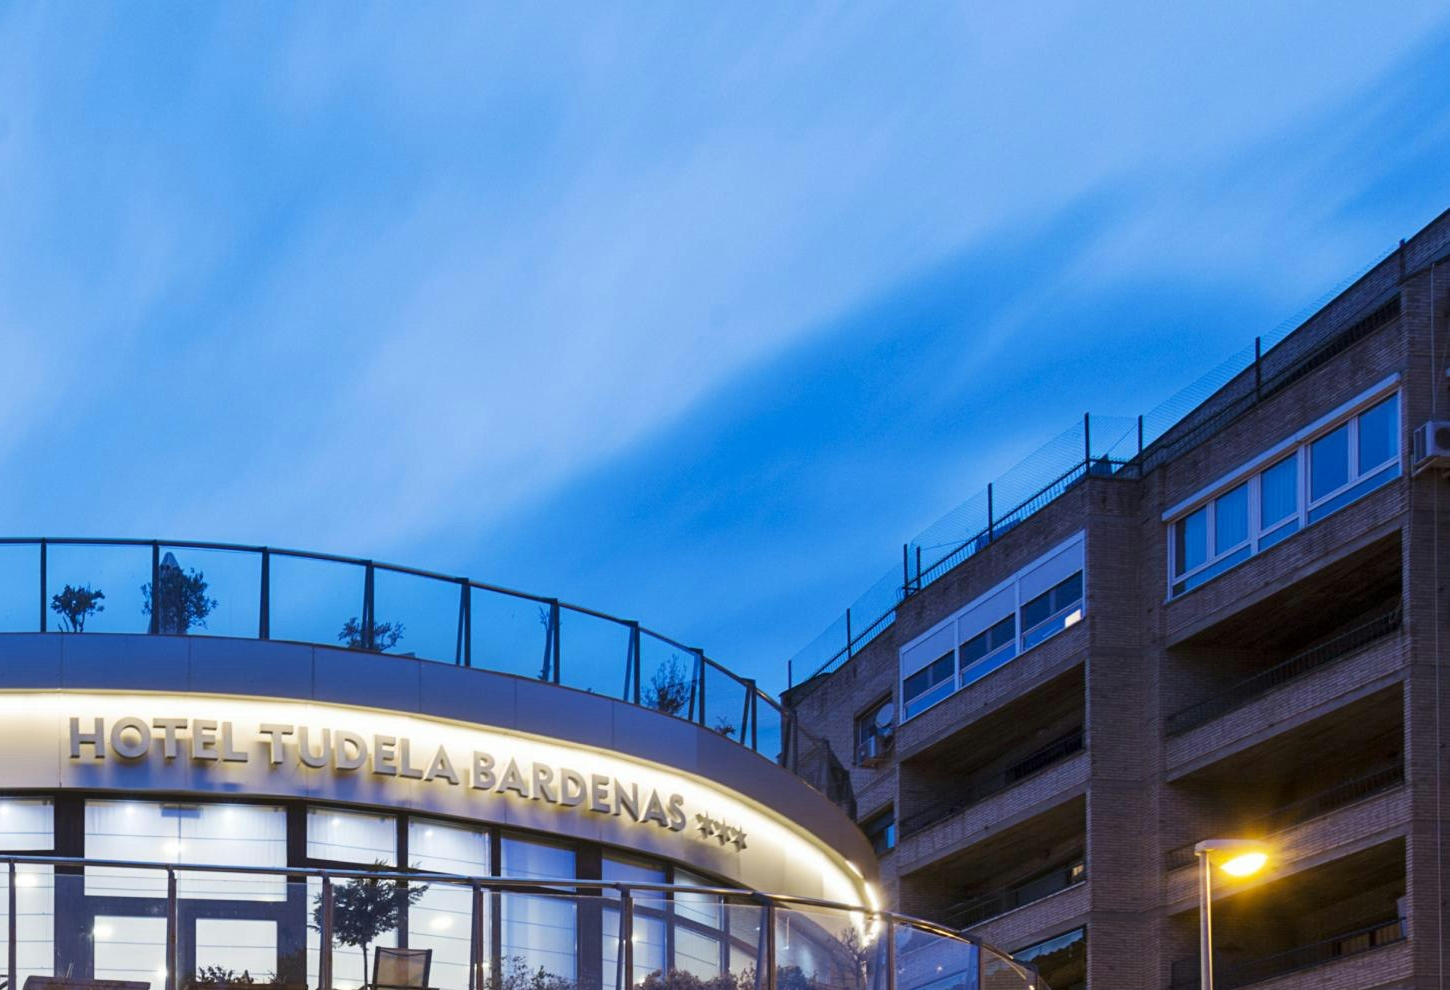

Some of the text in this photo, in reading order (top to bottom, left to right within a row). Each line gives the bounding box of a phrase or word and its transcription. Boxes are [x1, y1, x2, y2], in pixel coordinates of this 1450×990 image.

[69, 716, 687, 832] HOTEL TUDELA BARDENAS
